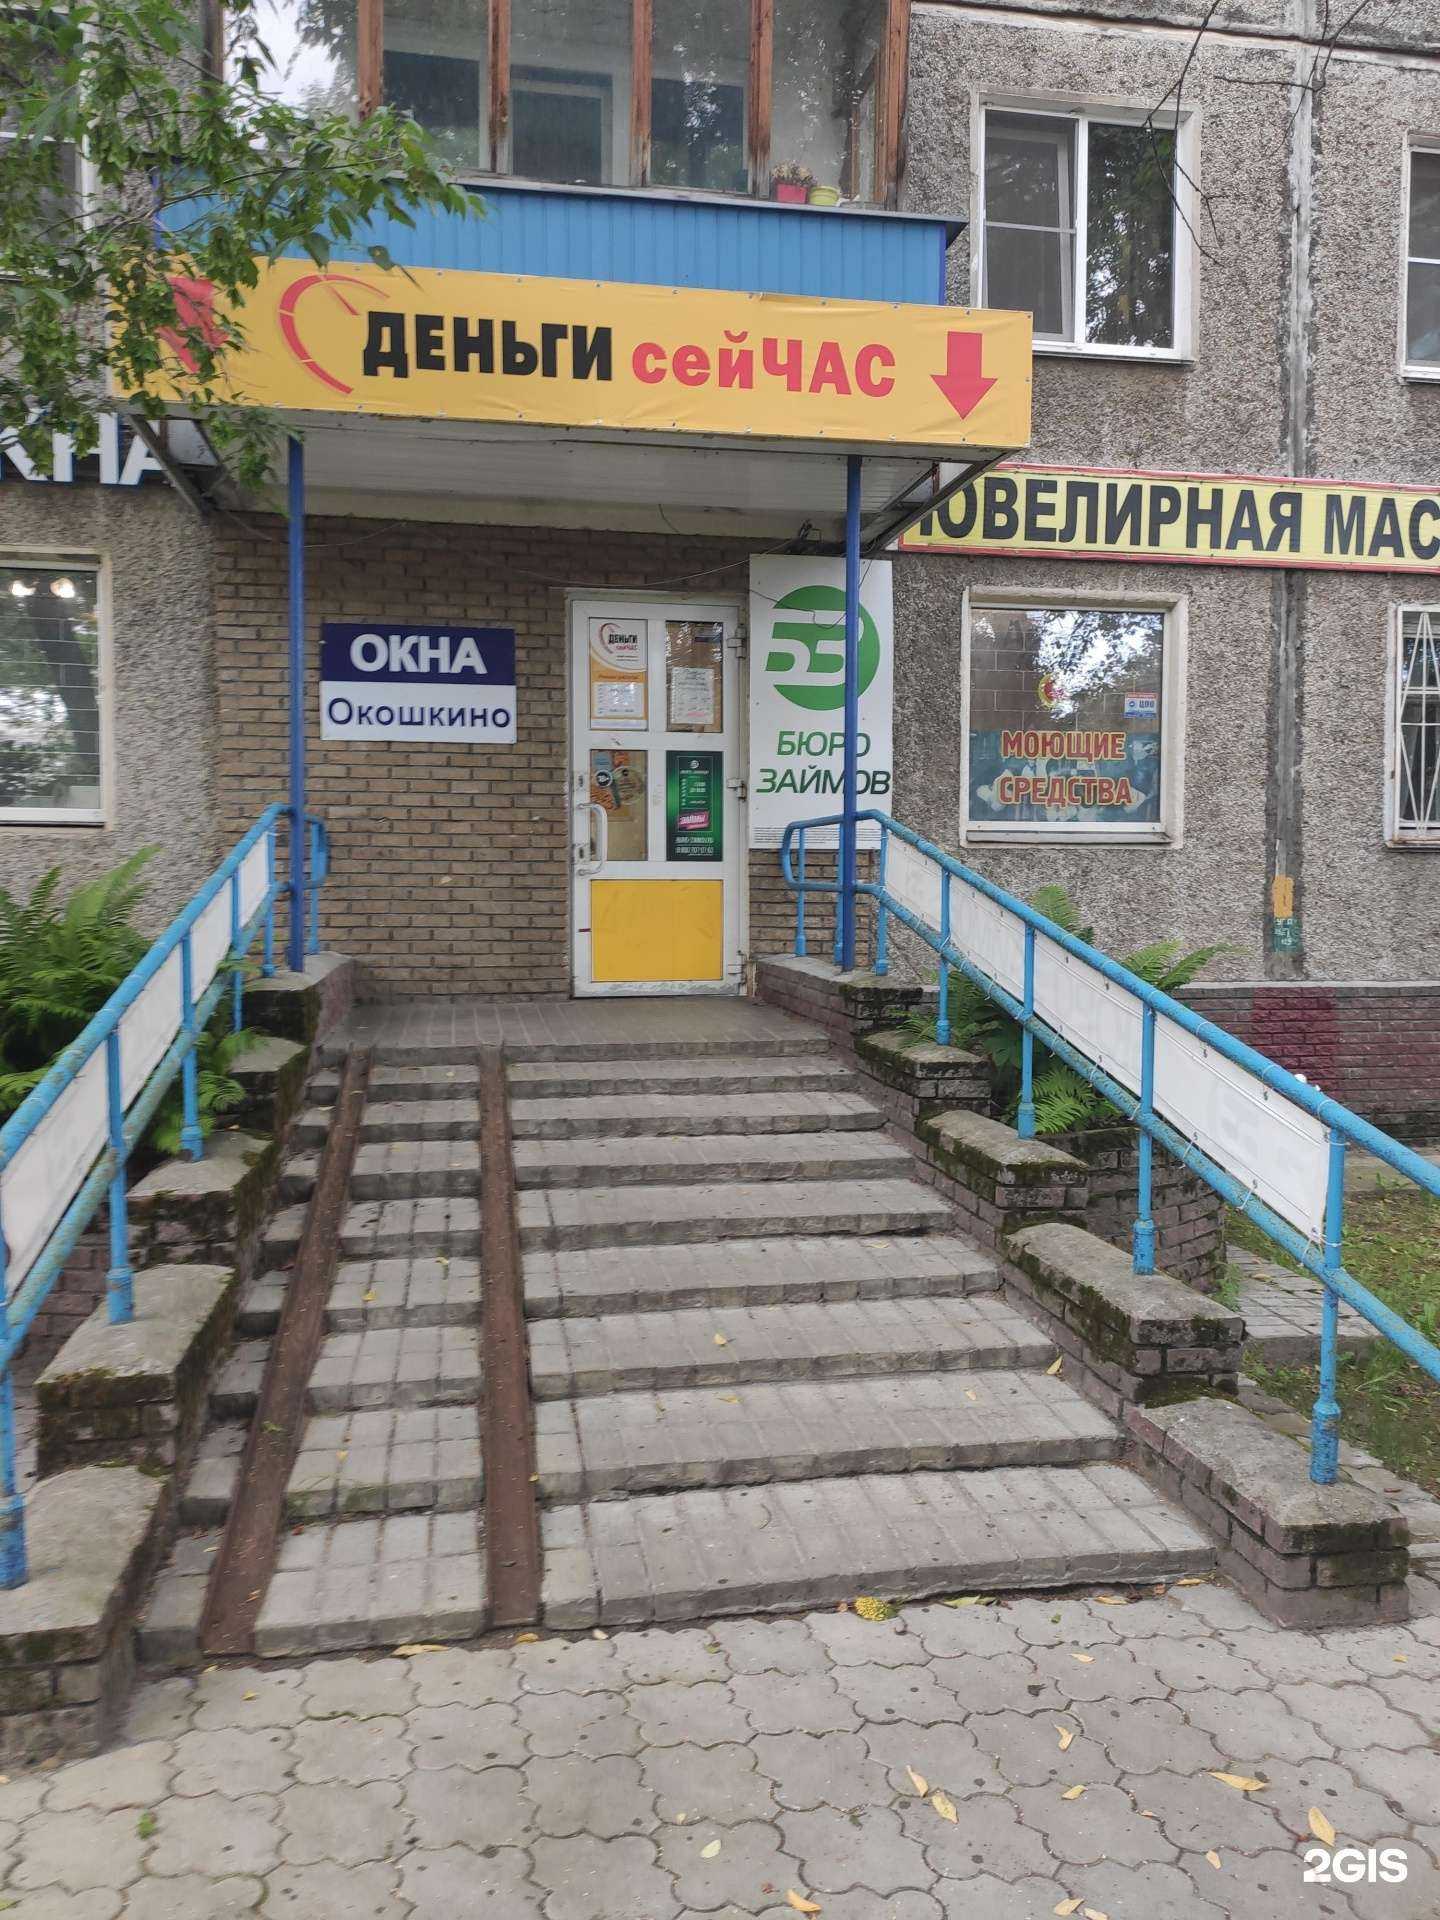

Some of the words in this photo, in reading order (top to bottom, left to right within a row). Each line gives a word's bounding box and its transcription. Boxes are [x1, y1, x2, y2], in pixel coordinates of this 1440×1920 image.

[363, 310, 613, 381] ДЕНЬГИ
[631, 329, 896, 398] сейЧАС
[918, 475, 1303, 554] ЮВЕЛИРНАЯ
[350, 633, 488, 675] ОКНА
[608, 634, 638, 645] ДЕНЬГИ
[328, 697, 511, 728] Окошкино
[777, 730, 871, 757] БЮРО
[1001, 730, 1127, 763] МОЮЩИЕ
[755, 764, 892, 795] ЗАЙМОВ
[999, 776, 1134, 808] СРЕДСТВА
